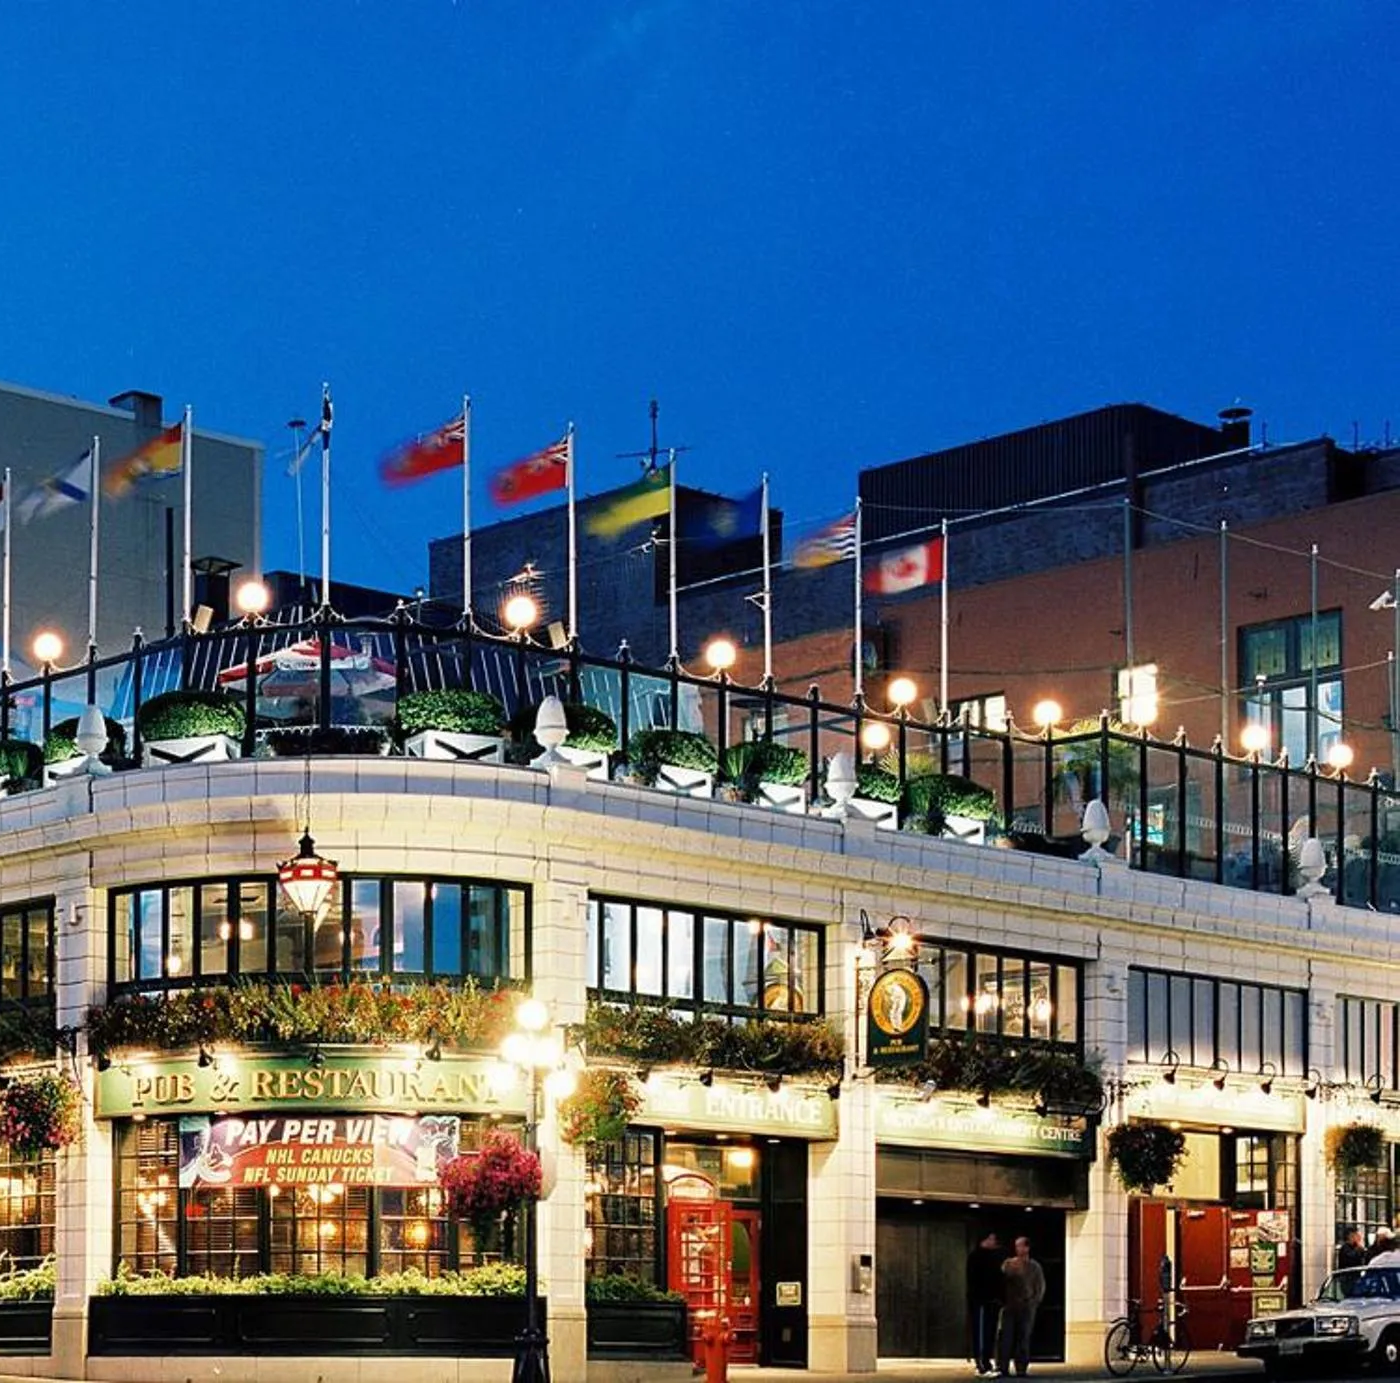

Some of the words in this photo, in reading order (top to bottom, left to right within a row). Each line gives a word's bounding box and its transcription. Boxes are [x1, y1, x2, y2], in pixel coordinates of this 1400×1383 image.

[131, 1072, 197, 1106] PUB
[208, 1073, 240, 1102] &
[250, 1067, 502, 1104] RESTAURANT
[705, 1089, 822, 1124] ENTRANCE
[225, 1119, 276, 1146] PAY
[281, 1119, 336, 1145] PER
[344, 1119, 417, 1145] VIEW
[1041, 1126, 1082, 1142] CENTRE
[266, 1148, 295, 1165] NHL
[301, 1148, 374, 1165] CANUCKS
[243, 1167, 271, 1183] NFL
[275, 1167, 338, 1183] SUNDAY
[342, 1166, 393, 1183] TICKET
